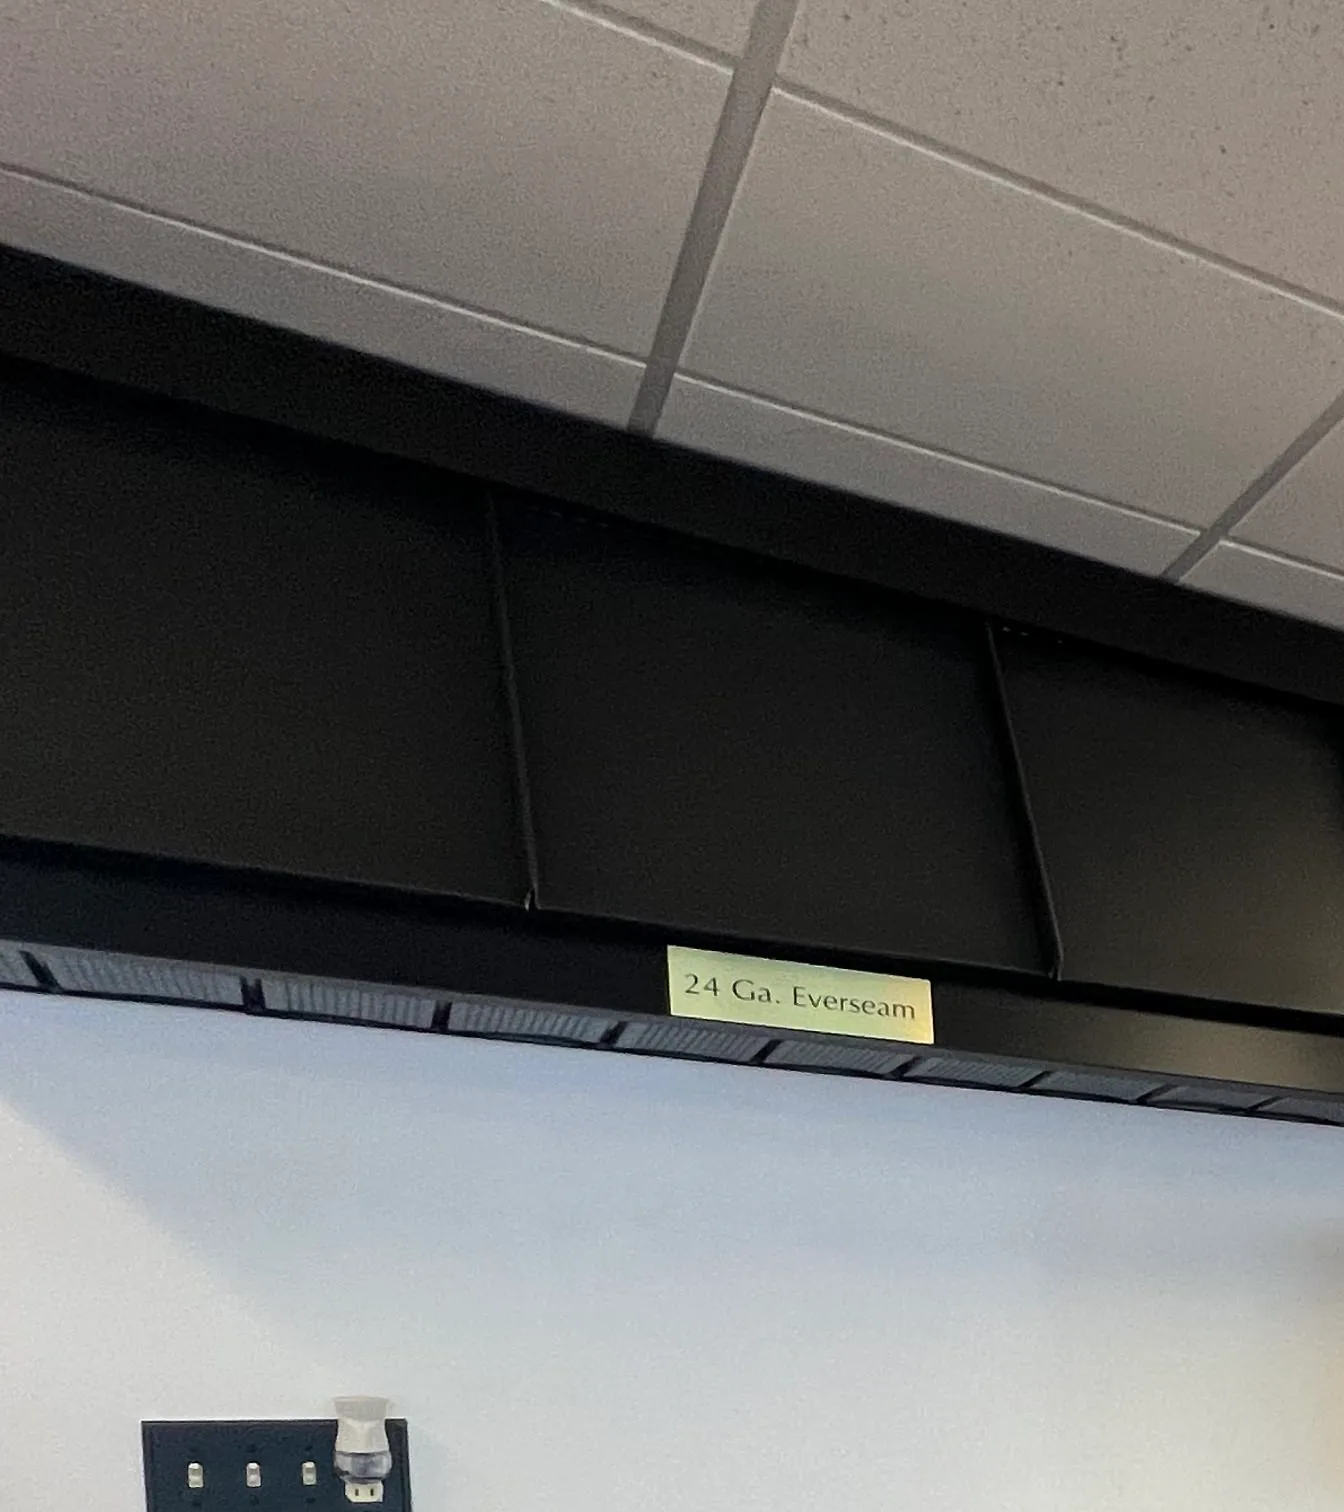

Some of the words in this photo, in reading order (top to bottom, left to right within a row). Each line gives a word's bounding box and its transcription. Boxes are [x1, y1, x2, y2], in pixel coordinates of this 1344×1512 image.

[684, 973, 720, 996] 24
[731, 979, 780, 1004] Ga.
[793, 986, 916, 1020] Everseam
